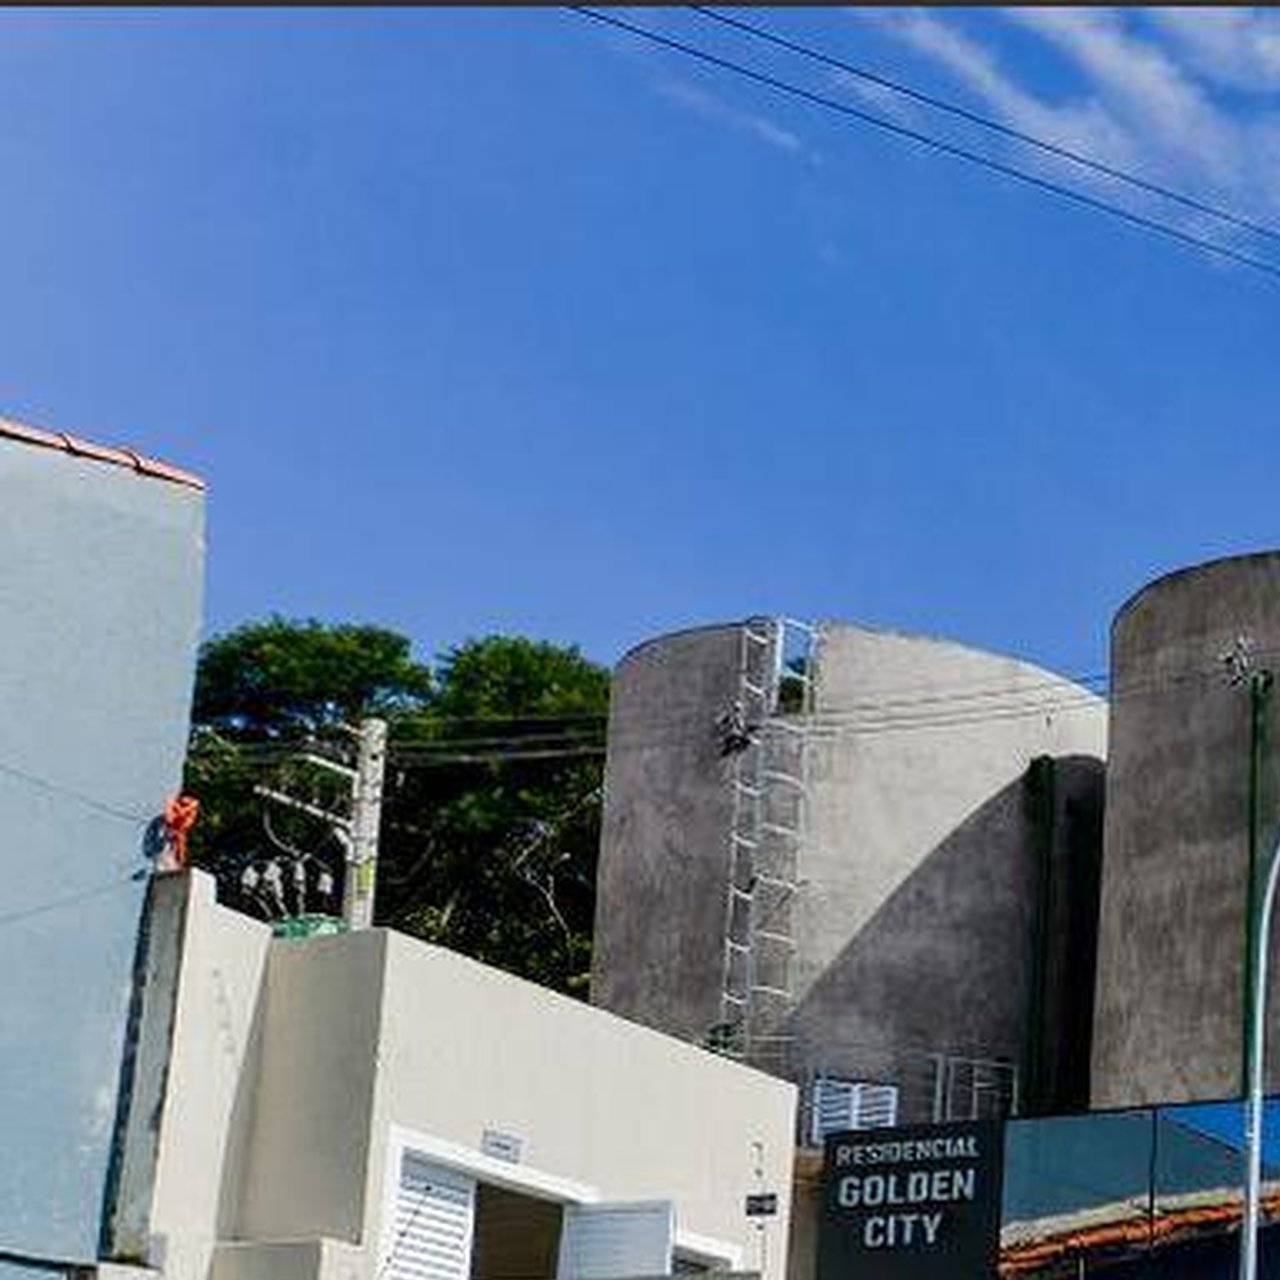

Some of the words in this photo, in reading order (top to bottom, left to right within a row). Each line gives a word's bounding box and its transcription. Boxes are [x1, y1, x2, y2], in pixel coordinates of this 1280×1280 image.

[836, 1137, 979, 1166] RESIDENCIAL
[838, 1169, 975, 1206] GOLDEN
[864, 1212, 942, 1247] CITY
